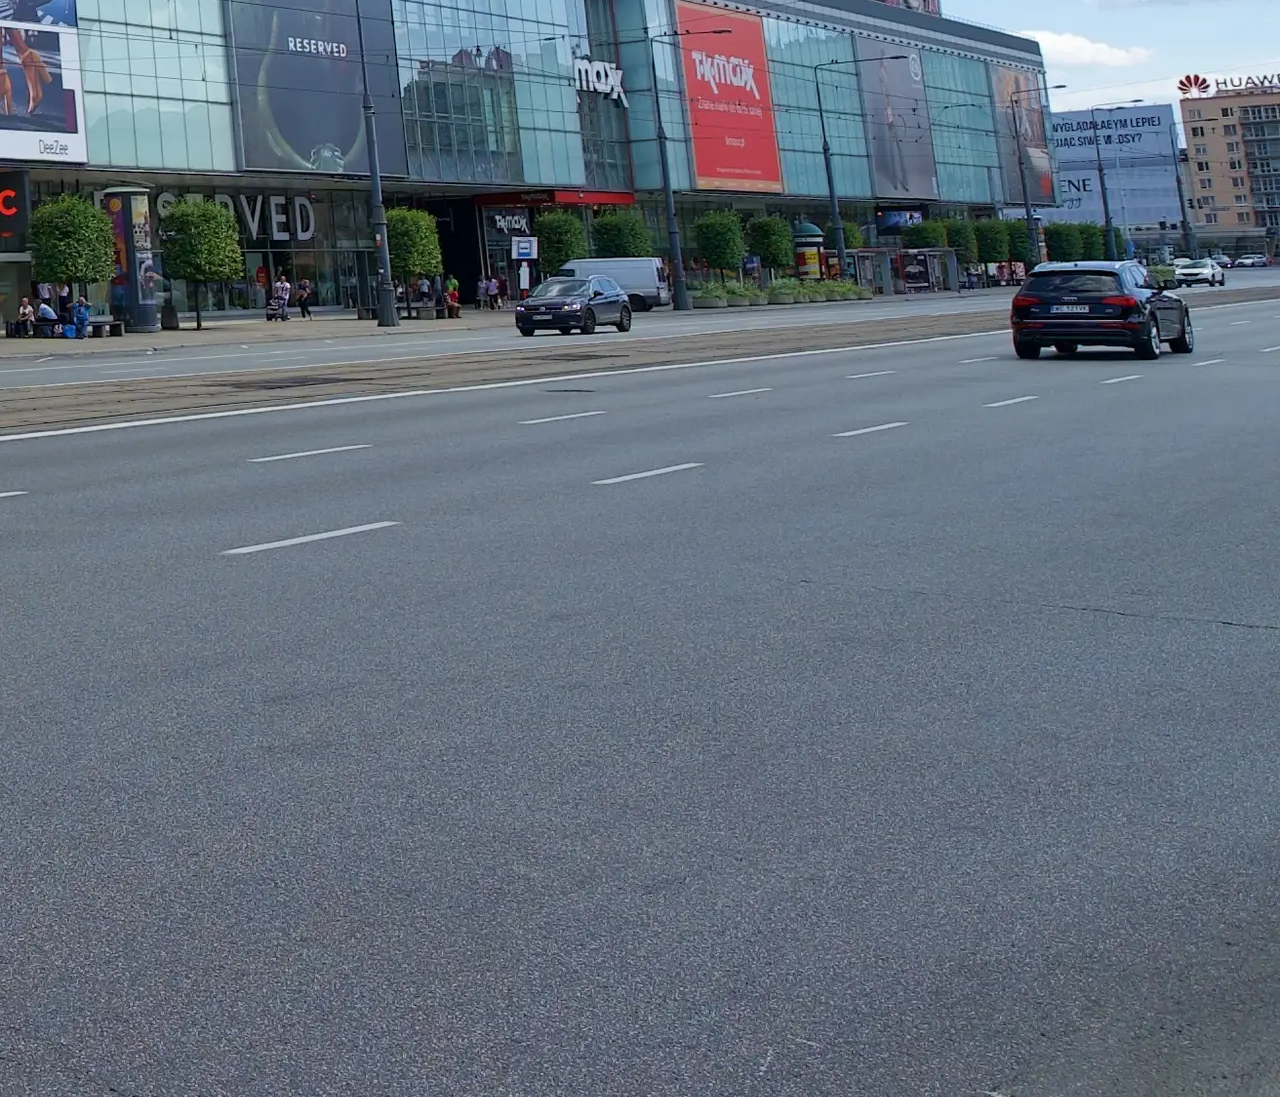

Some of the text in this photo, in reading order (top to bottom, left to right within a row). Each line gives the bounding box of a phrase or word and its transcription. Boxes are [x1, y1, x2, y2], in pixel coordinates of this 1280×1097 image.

[288, 36, 347, 58] RESERVED
[1130, 116, 1161, 130] LEPIEJ
[39, 139, 69, 155] DeeZee
[1077, 135, 1102, 147] SIWE
